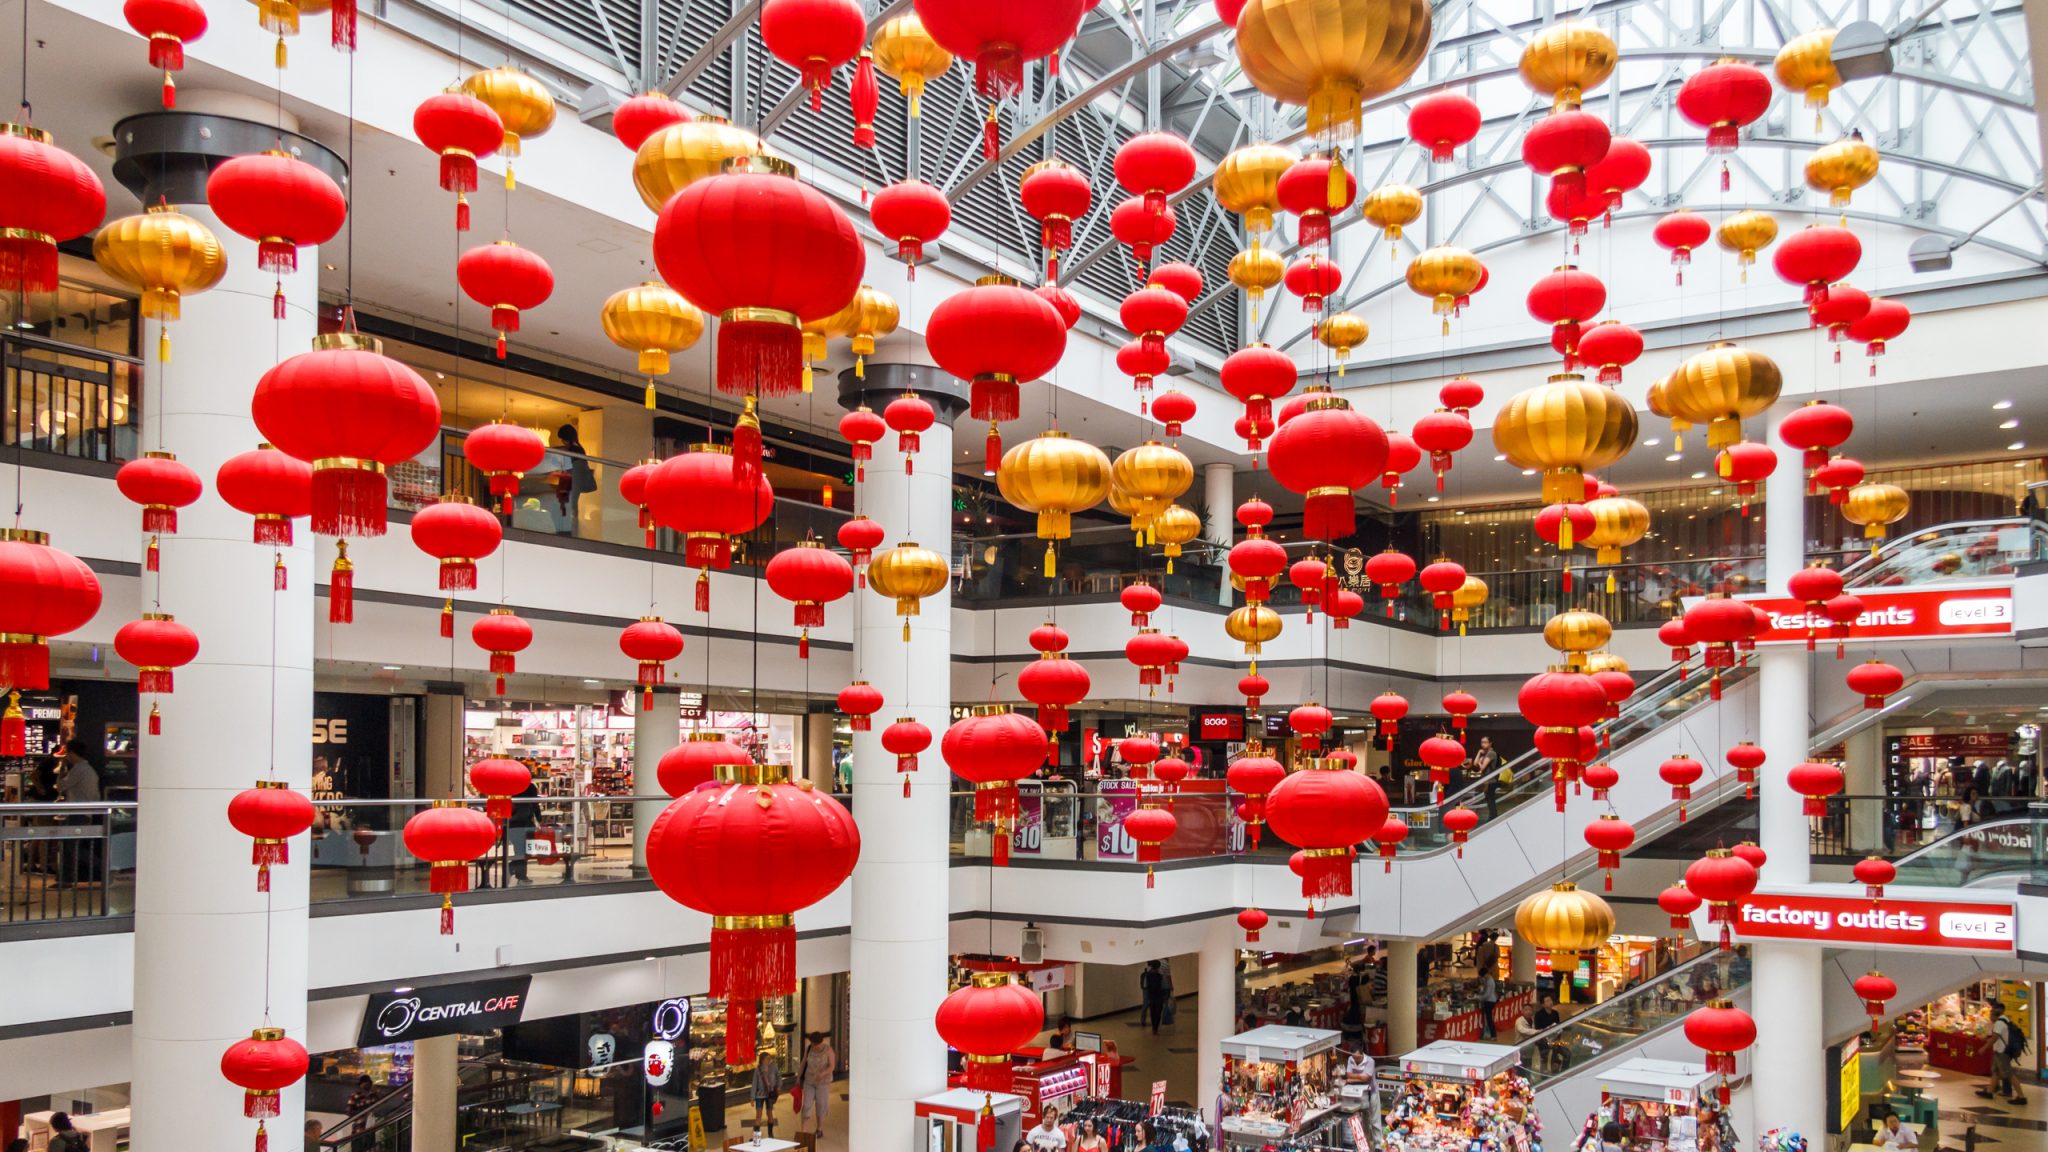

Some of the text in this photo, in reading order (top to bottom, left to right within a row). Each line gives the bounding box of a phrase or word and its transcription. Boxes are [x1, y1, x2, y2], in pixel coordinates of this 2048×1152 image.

[1769, 606, 1914, 629] Restaants
[1951, 605, 2005, 619] level 3
[1902, 736, 1932, 747] SALE
[1958, 735, 1990, 746] 70%
[1099, 781, 1137, 790] STOCK SALE
[1013, 826, 1041, 849] $10
[1101, 823, 1135, 855] $10
[1741, 903, 1927, 931] factory outlets
[1950, 920, 2006, 934] level 2
[418, 995, 520, 1022] CENTRAL CAFE
[1468, 1012, 1484, 1033] SAL
